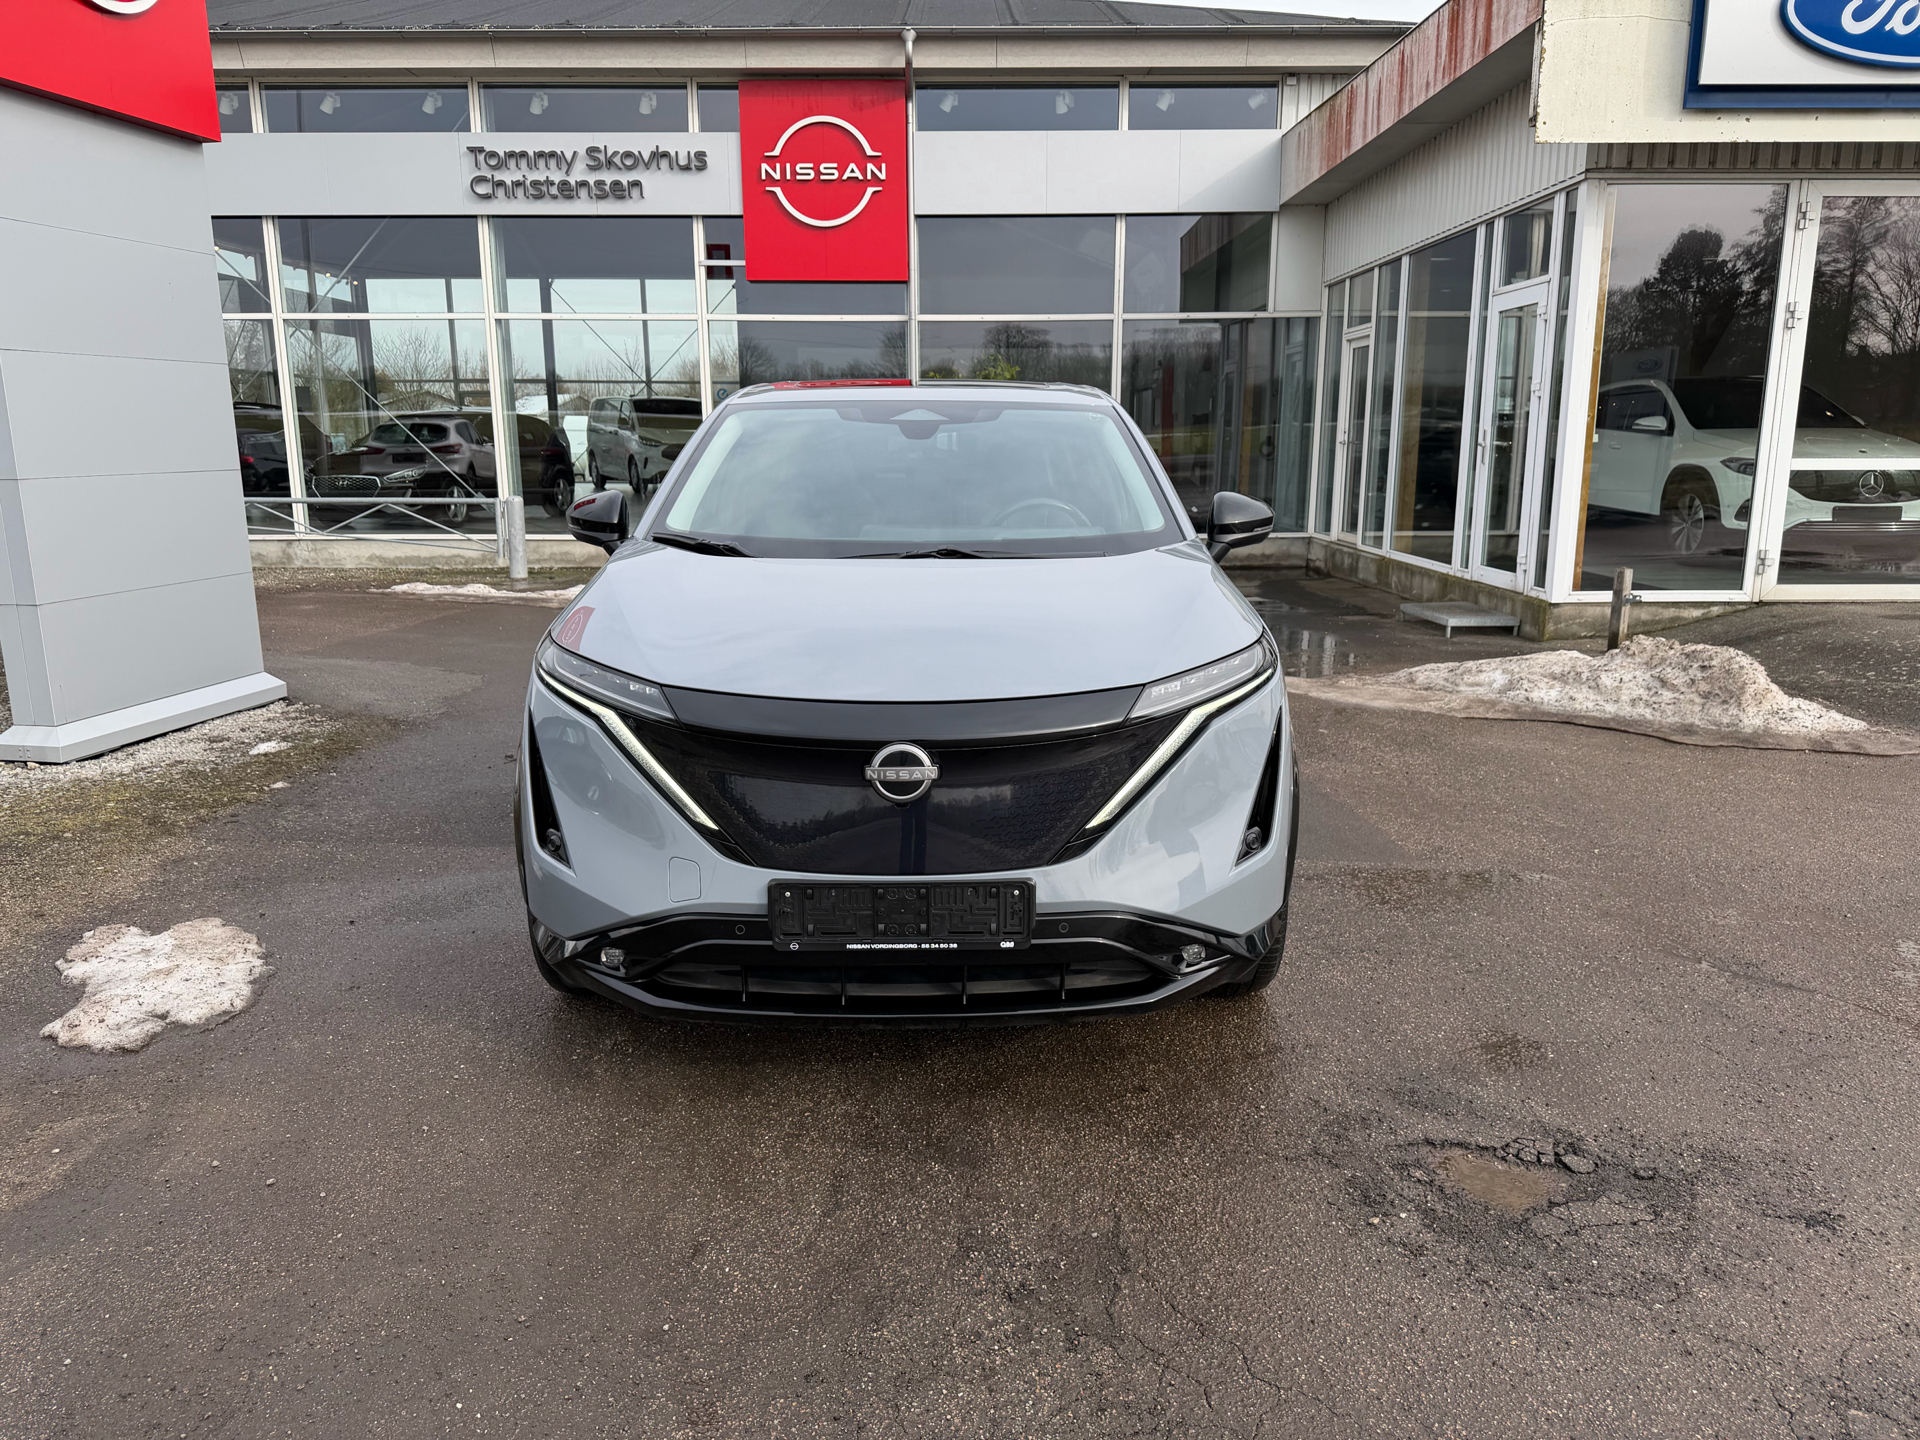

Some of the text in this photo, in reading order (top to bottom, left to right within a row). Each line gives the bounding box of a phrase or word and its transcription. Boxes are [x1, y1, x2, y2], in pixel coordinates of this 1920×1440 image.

[466, 145, 708, 176] Tommy Skovhus
[760, 162, 887, 181] NISSAN
[469, 174, 645, 199] Christensen
[866, 769, 936, 780] NISSAN
